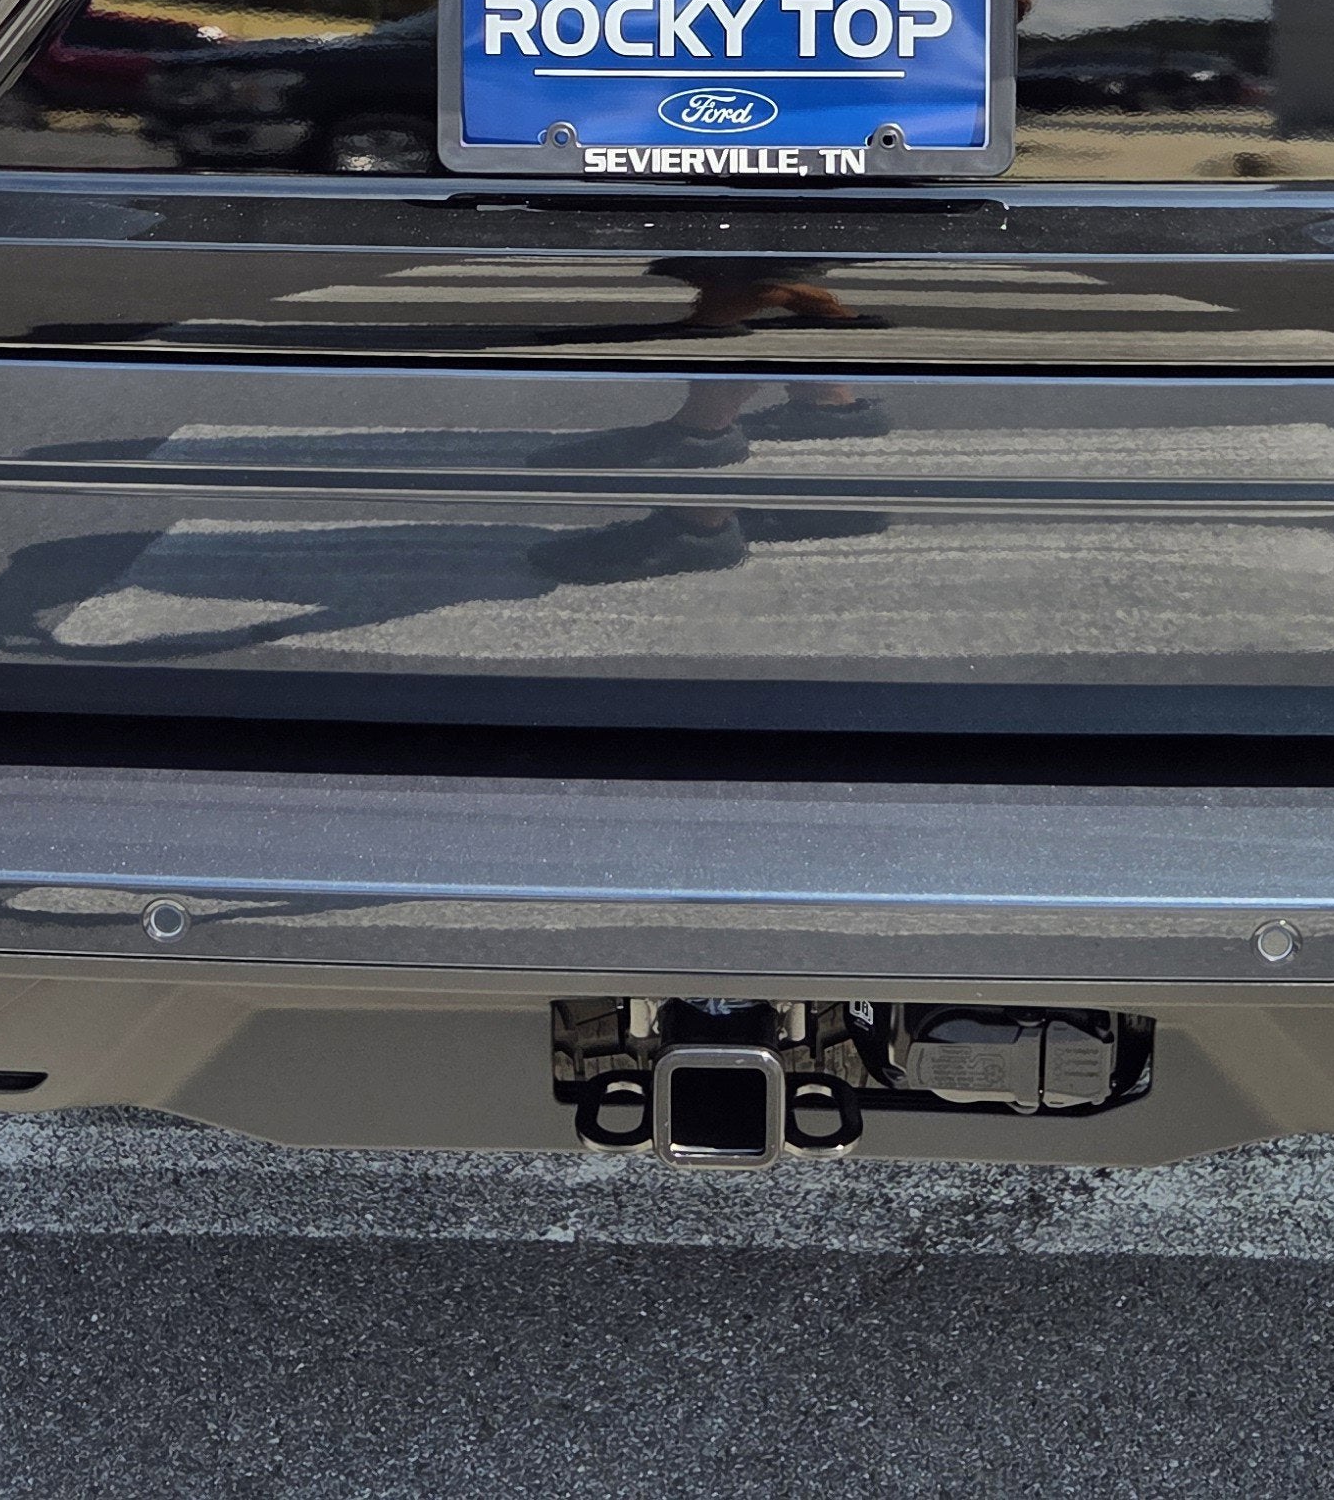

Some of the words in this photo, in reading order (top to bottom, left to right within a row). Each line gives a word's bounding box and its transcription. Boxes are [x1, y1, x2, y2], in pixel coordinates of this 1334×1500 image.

[680, 94, 754, 125] Ford
[584, 147, 809, 177] SEVIERVILLE,
[817, 148, 866, 175] TN
